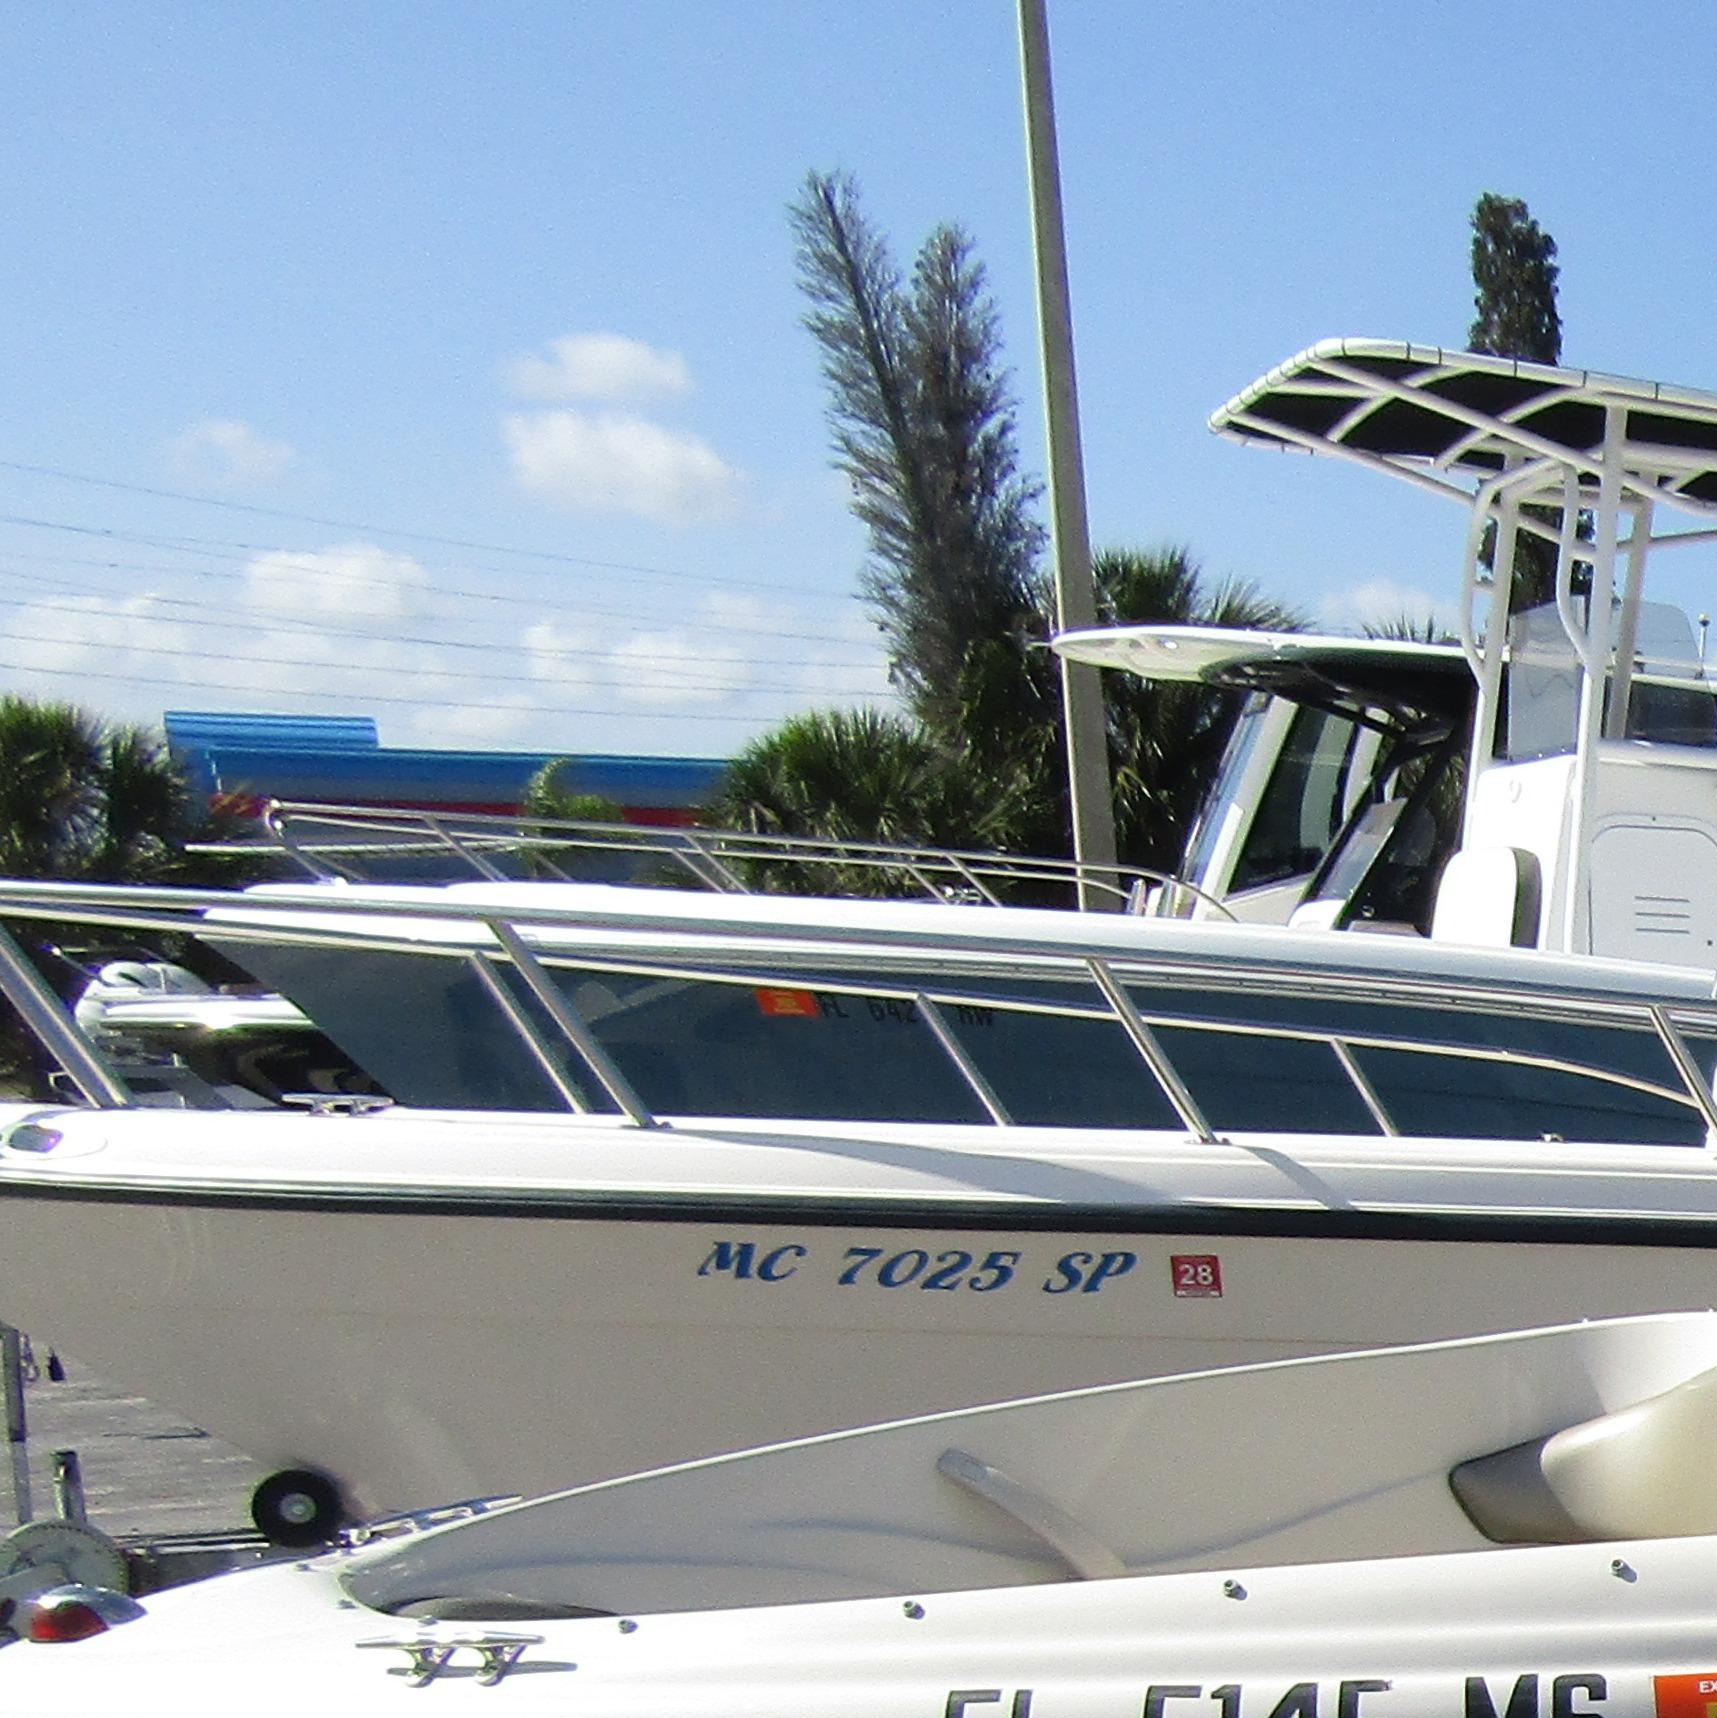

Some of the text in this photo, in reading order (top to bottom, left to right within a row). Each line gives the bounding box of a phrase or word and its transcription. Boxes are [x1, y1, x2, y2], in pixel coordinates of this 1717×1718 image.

[697, 1241, 1138, 1294] MC 7025 SP
[1178, 1263, 1214, 1286] 28
